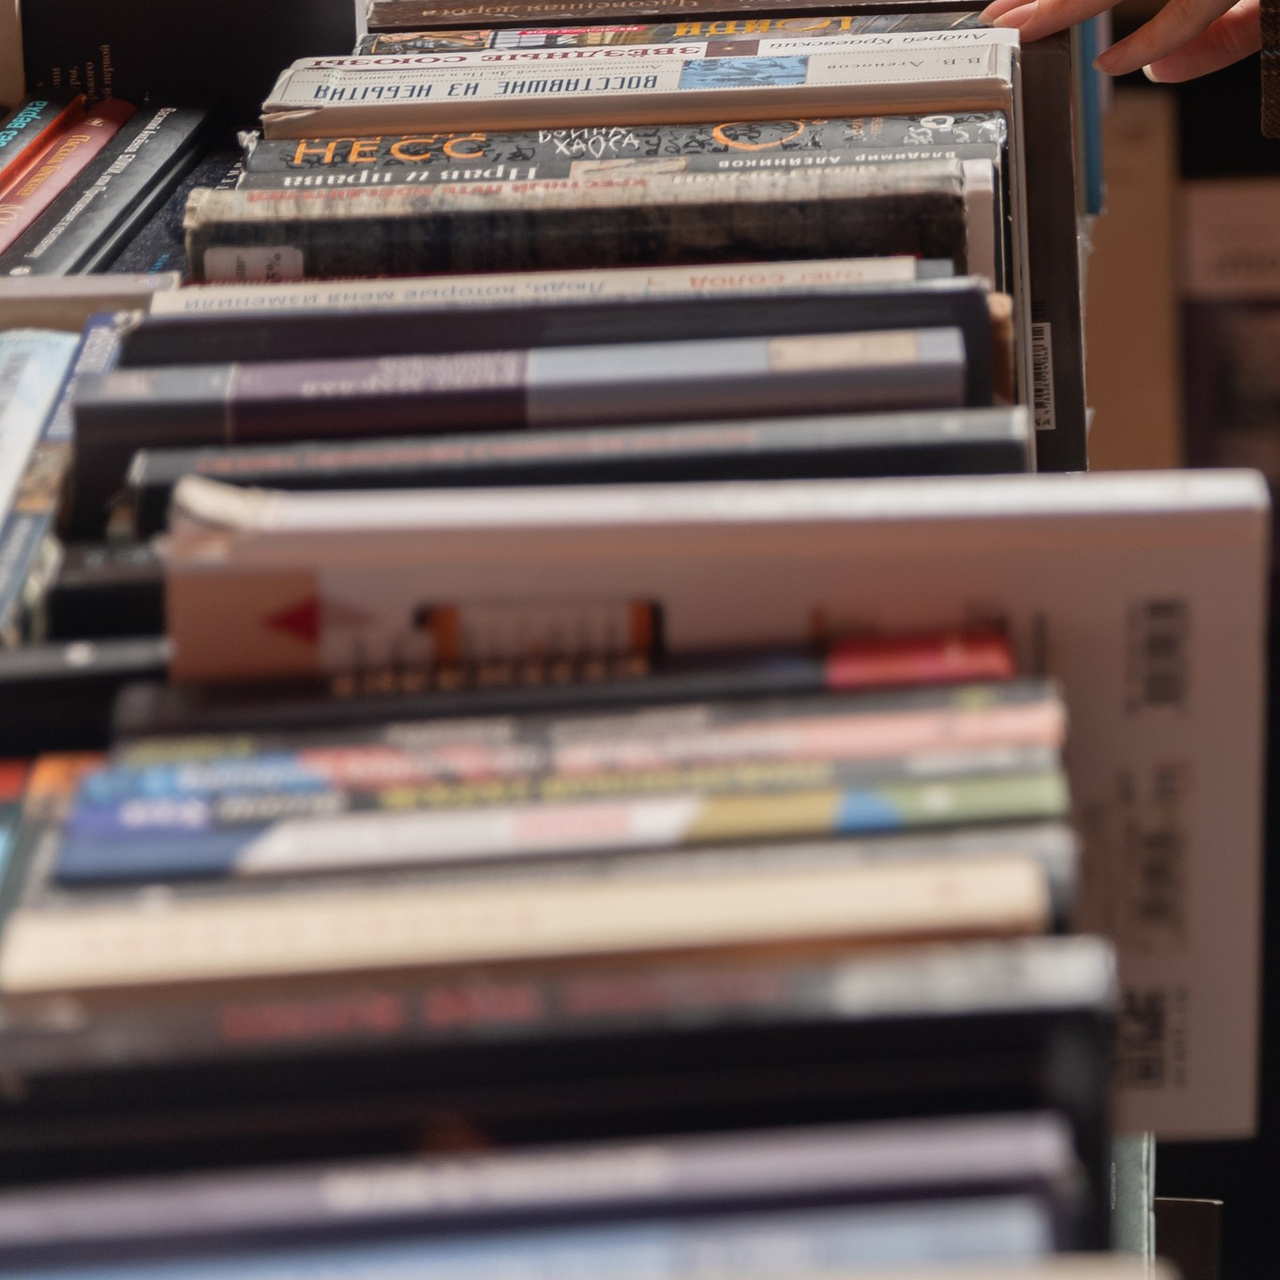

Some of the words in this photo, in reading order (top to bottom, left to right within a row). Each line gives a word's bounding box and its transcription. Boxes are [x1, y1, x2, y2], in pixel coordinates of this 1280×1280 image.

[421, 3, 519, 18] дорога
[768, 37, 893, 51] Краевский
[902, 32, 988, 44] Андрей
[310, 55, 467, 68] СОЮЗЫ
[481, 46, 701, 63] ЗВЁЗДНЫЕ
[826, 61, 924, 71] Агеносов
[447, 83, 479, 96] ИЗ
[497, 74, 658, 95] ВОССТАВШИЕ
[312, 85, 433, 102] НЕБЫТИЯ
[5, 100, 49, 129] верха
[293, 137, 487, 165] НЕСС
[553, 132, 640, 159] ХАОСА
[718, 155, 842, 169] АЛЕЙНИКОВ
[855, 151, 957, 164] Владимир
[282, 173, 392, 188] права
[405, 169, 431, 183] и
[440, 164, 537, 182] Нрав
[511, 178, 647, 194] КРЕСТНЫЙ
[524, 279, 607, 298] Люди,
[689, 274, 785, 288] СОЛОД
[327, 290, 395, 306] меня
[402, 284, 515, 301] которые
[184, 293, 319, 312] изменили
